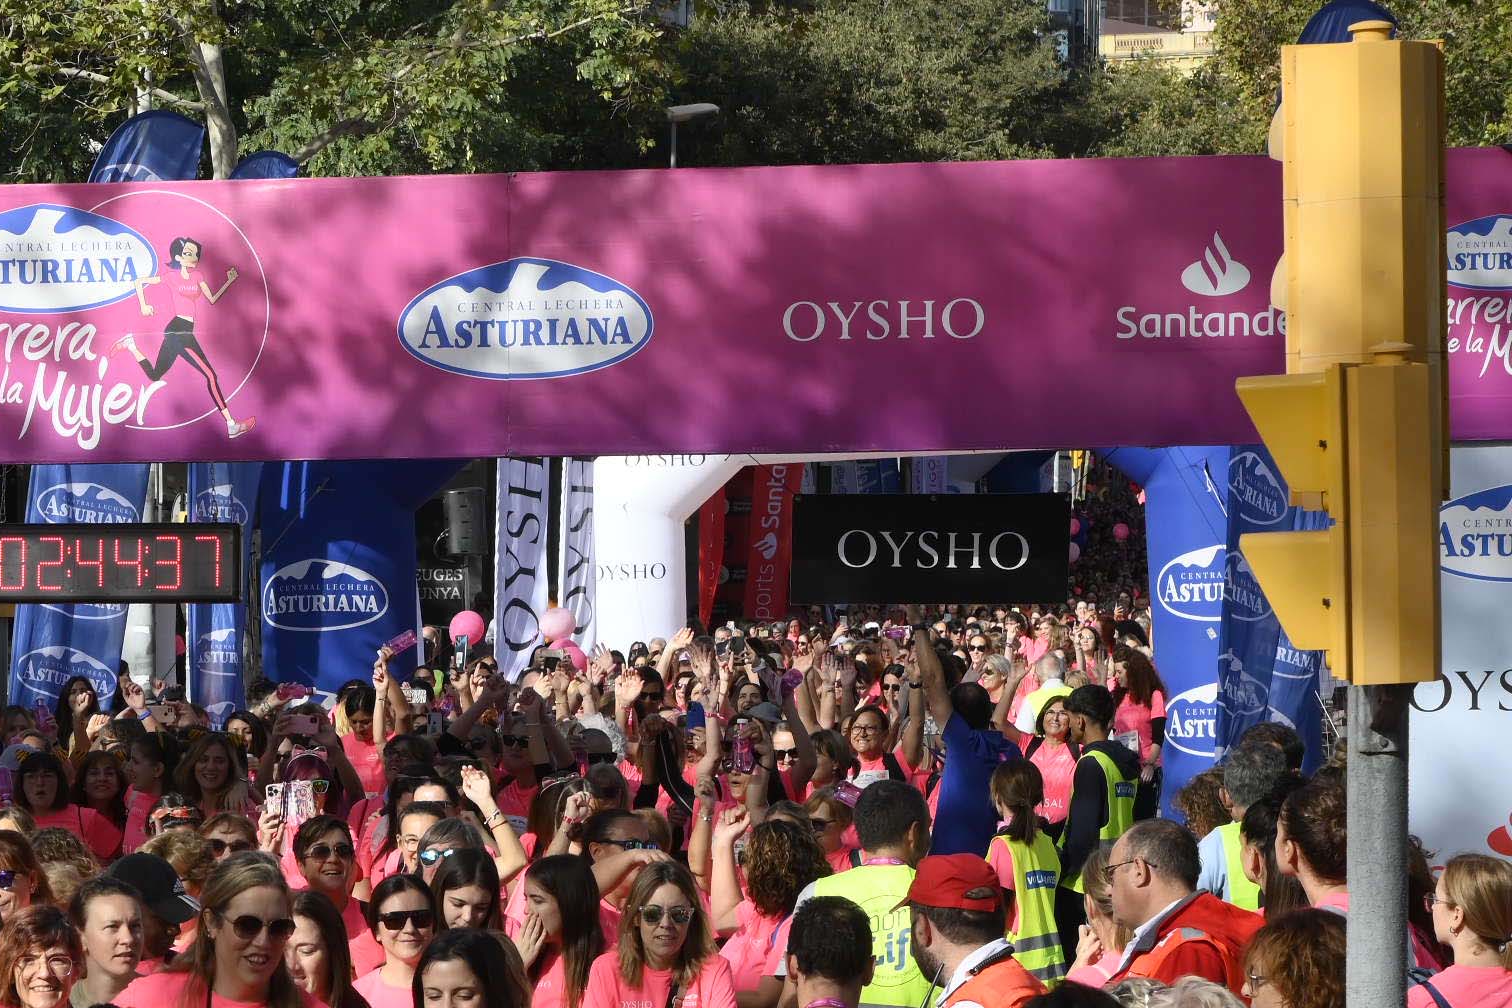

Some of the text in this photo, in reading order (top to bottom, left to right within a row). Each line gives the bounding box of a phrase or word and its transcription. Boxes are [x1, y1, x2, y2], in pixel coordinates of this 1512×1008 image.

[60, 240, 133, 253] LECHERA
[456, 298, 625, 314] CENTRAL LECHERA
[782, 297, 986, 342] OYSHO
[417, 304, 634, 350] ASTURIANA
[1116, 305, 1287, 339] Santand
[1466, 326, 1484, 352] la
[17, 356, 167, 450] Mujer
[838, 529, 1029, 571] OYSHO
[267, 587, 379, 615] ASTURIANA
[279, 583, 375, 593] CENTRAL LECHERA
